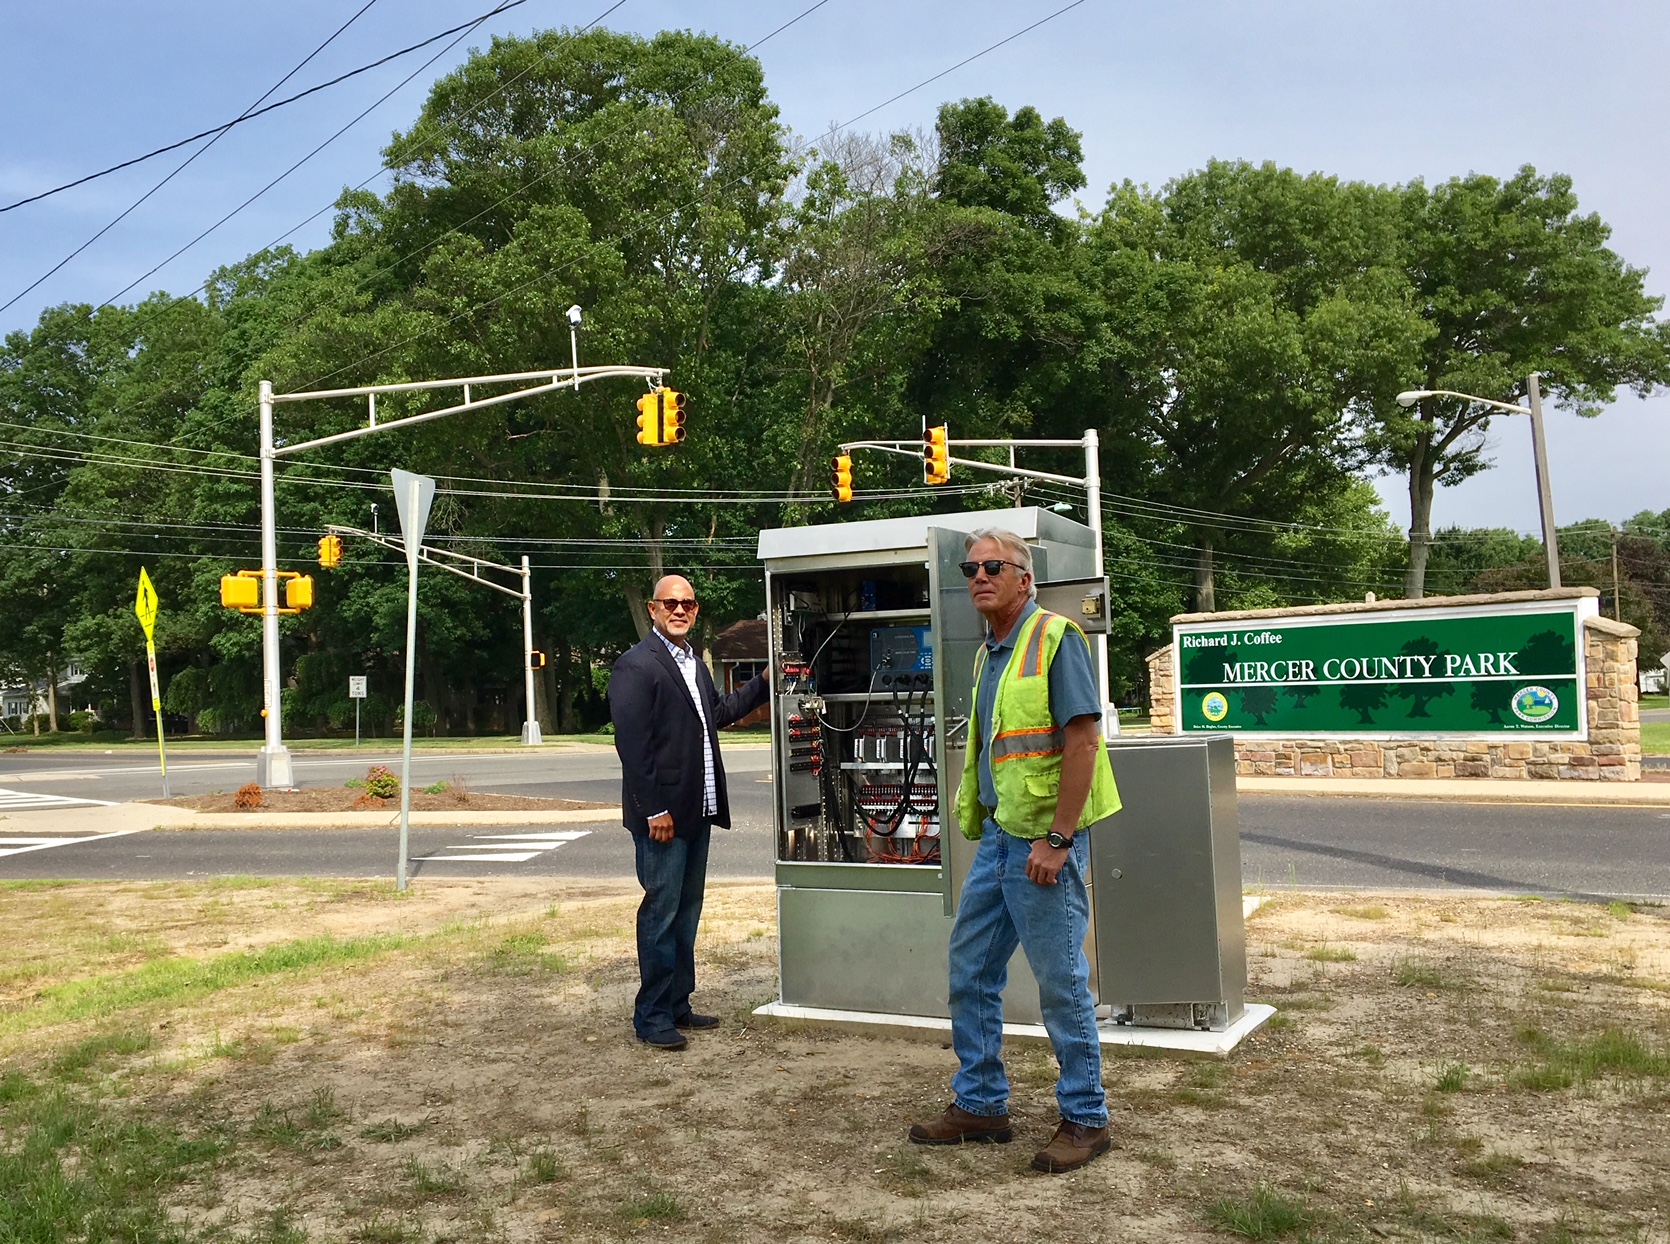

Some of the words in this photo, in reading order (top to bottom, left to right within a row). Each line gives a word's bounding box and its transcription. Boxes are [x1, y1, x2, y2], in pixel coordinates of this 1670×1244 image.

[1183, 634, 1228, 648] Richard
[1230, 633, 1242, 646] J.
[1244, 632, 1283, 645] Coffee
[1222, 659, 1317, 682] MERCER
[1323, 655, 1437, 680] COUNTY
[1444, 651, 1520, 677] PARK
[1514, 687, 1534, 700] MERCER
[1536, 687, 1556, 700] COUNTY
